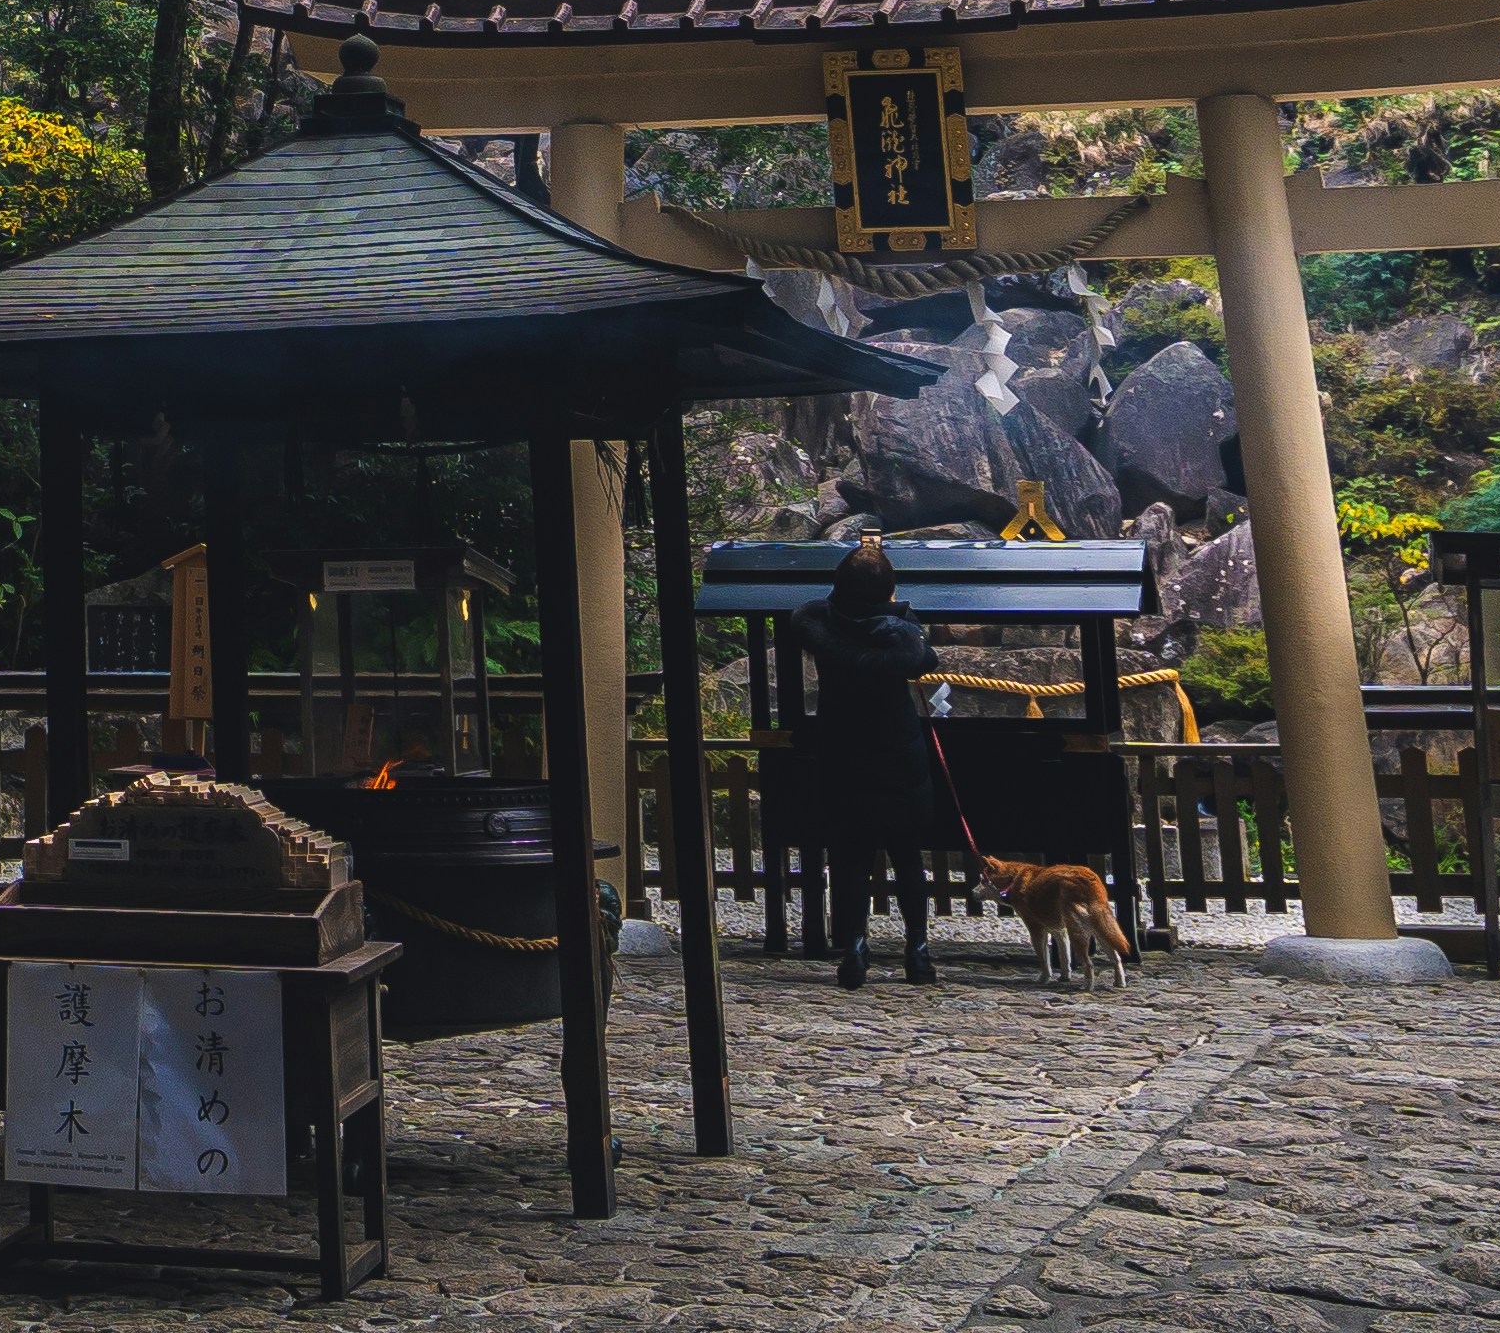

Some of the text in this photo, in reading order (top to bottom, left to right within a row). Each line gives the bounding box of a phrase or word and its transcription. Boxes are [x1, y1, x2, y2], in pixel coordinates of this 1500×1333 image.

[54, 983, 96, 1144] 護摩木
[194, 981, 231, 1177] お清めの
